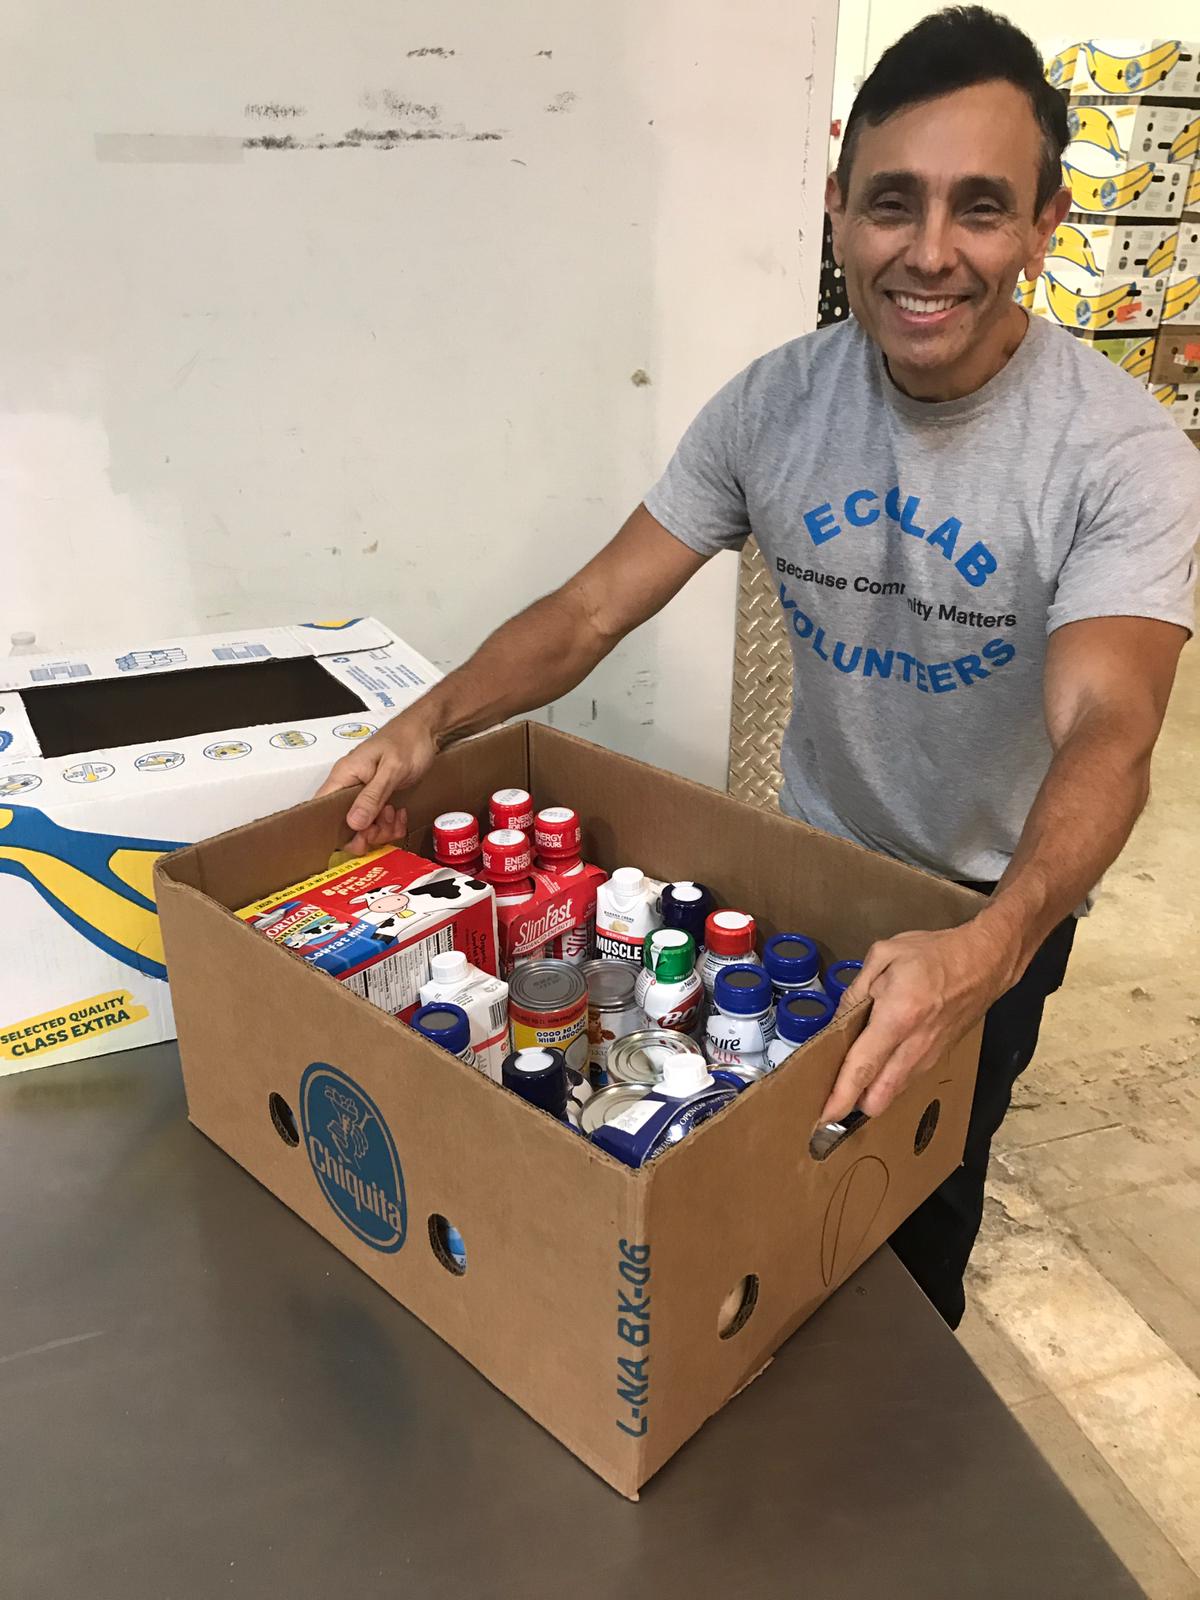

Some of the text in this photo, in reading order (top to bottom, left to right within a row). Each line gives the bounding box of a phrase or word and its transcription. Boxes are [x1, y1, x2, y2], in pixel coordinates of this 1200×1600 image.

[776, 557, 848, 590] Because
[938, 604, 1017, 628] Matters
[449, 848, 462, 856] FOR
[504, 864, 518, 872] FOR
[321, 888, 337, 896] 8
[337, 866, 385, 896] Protein
[265, 904, 322, 940] ORIZON
[274, 910, 324, 945] ORGANIC
[514, 898, 573, 947] SlimFast
[304, 936, 350, 960] Lowfat
[596, 934, 643, 961] MUSCLE
[0, 996, 125, 1045] SELECTED QUALITY
[11, 1009, 131, 1057] CLASS EXTRA
[712, 1046, 742, 1064] PLUS
[679, 1106, 697, 1126] OPEN
[309, 1135, 402, 1233] Chiquita
[616, 1238, 651, 1438] L-NA BK-06
